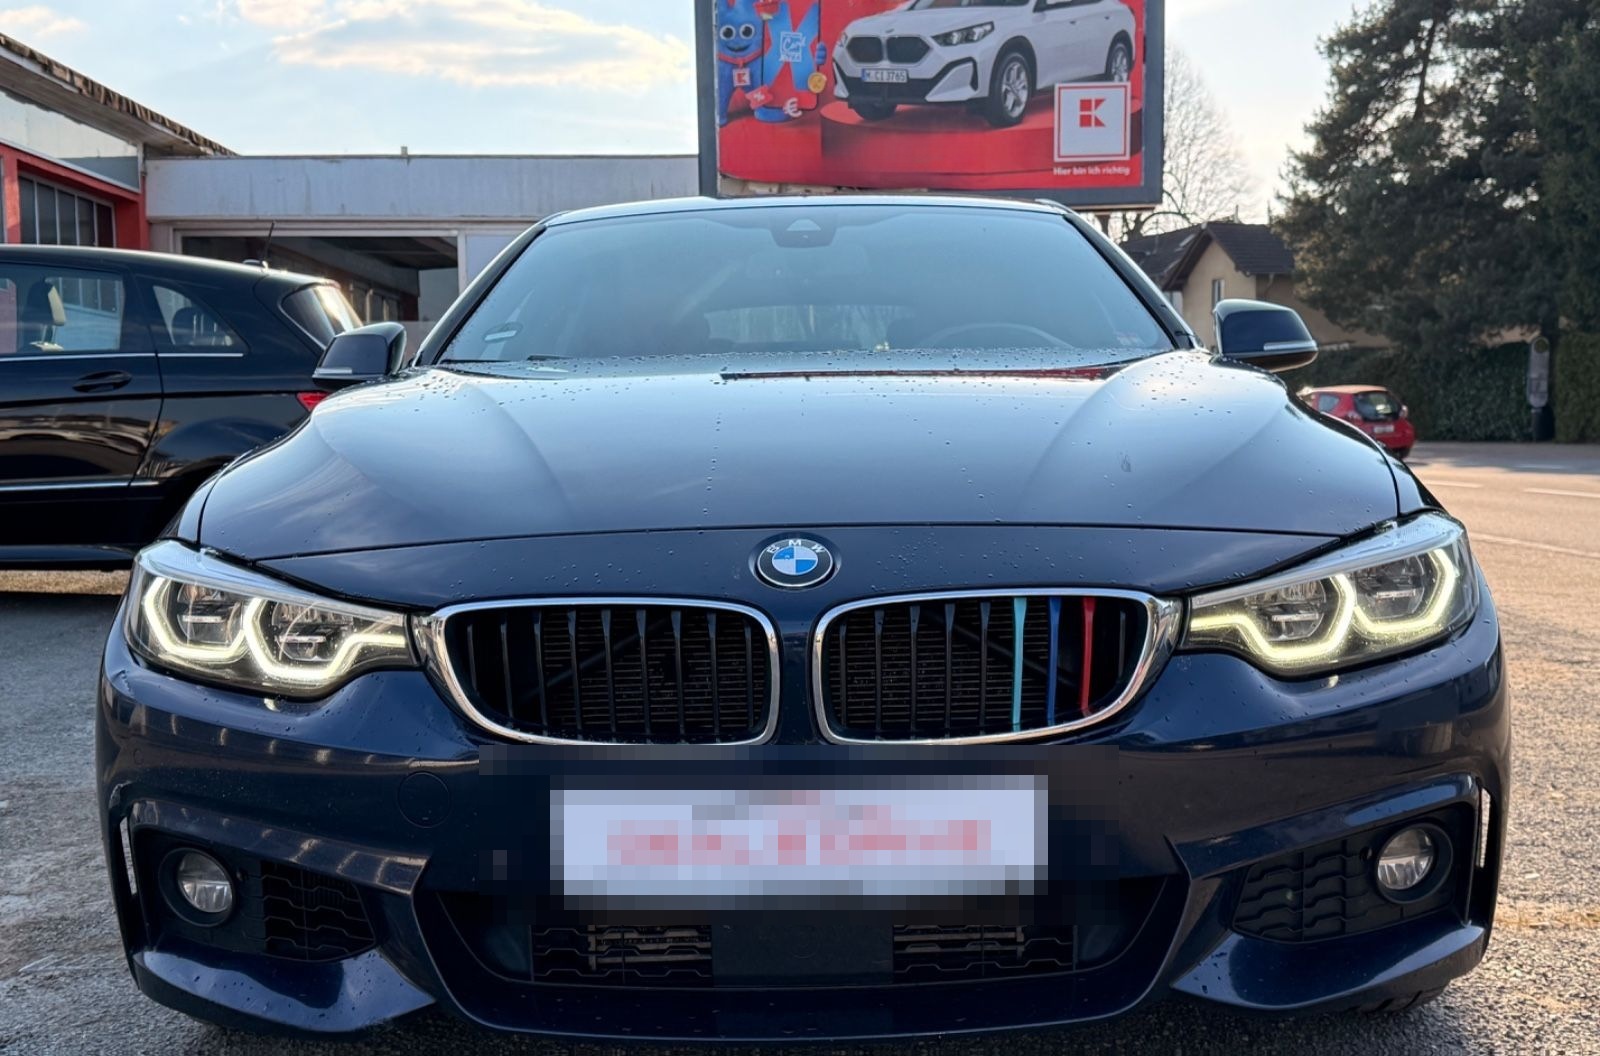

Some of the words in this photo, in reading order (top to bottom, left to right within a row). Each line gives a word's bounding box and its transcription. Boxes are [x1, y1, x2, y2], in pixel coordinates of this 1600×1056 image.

[1053, 166, 1071, 175] Hier
[1072, 166, 1087, 175] bin
[1087, 166, 1101, 175] ich
[1102, 165, 1130, 176] richtig
[766, 539, 826, 553] BMW
